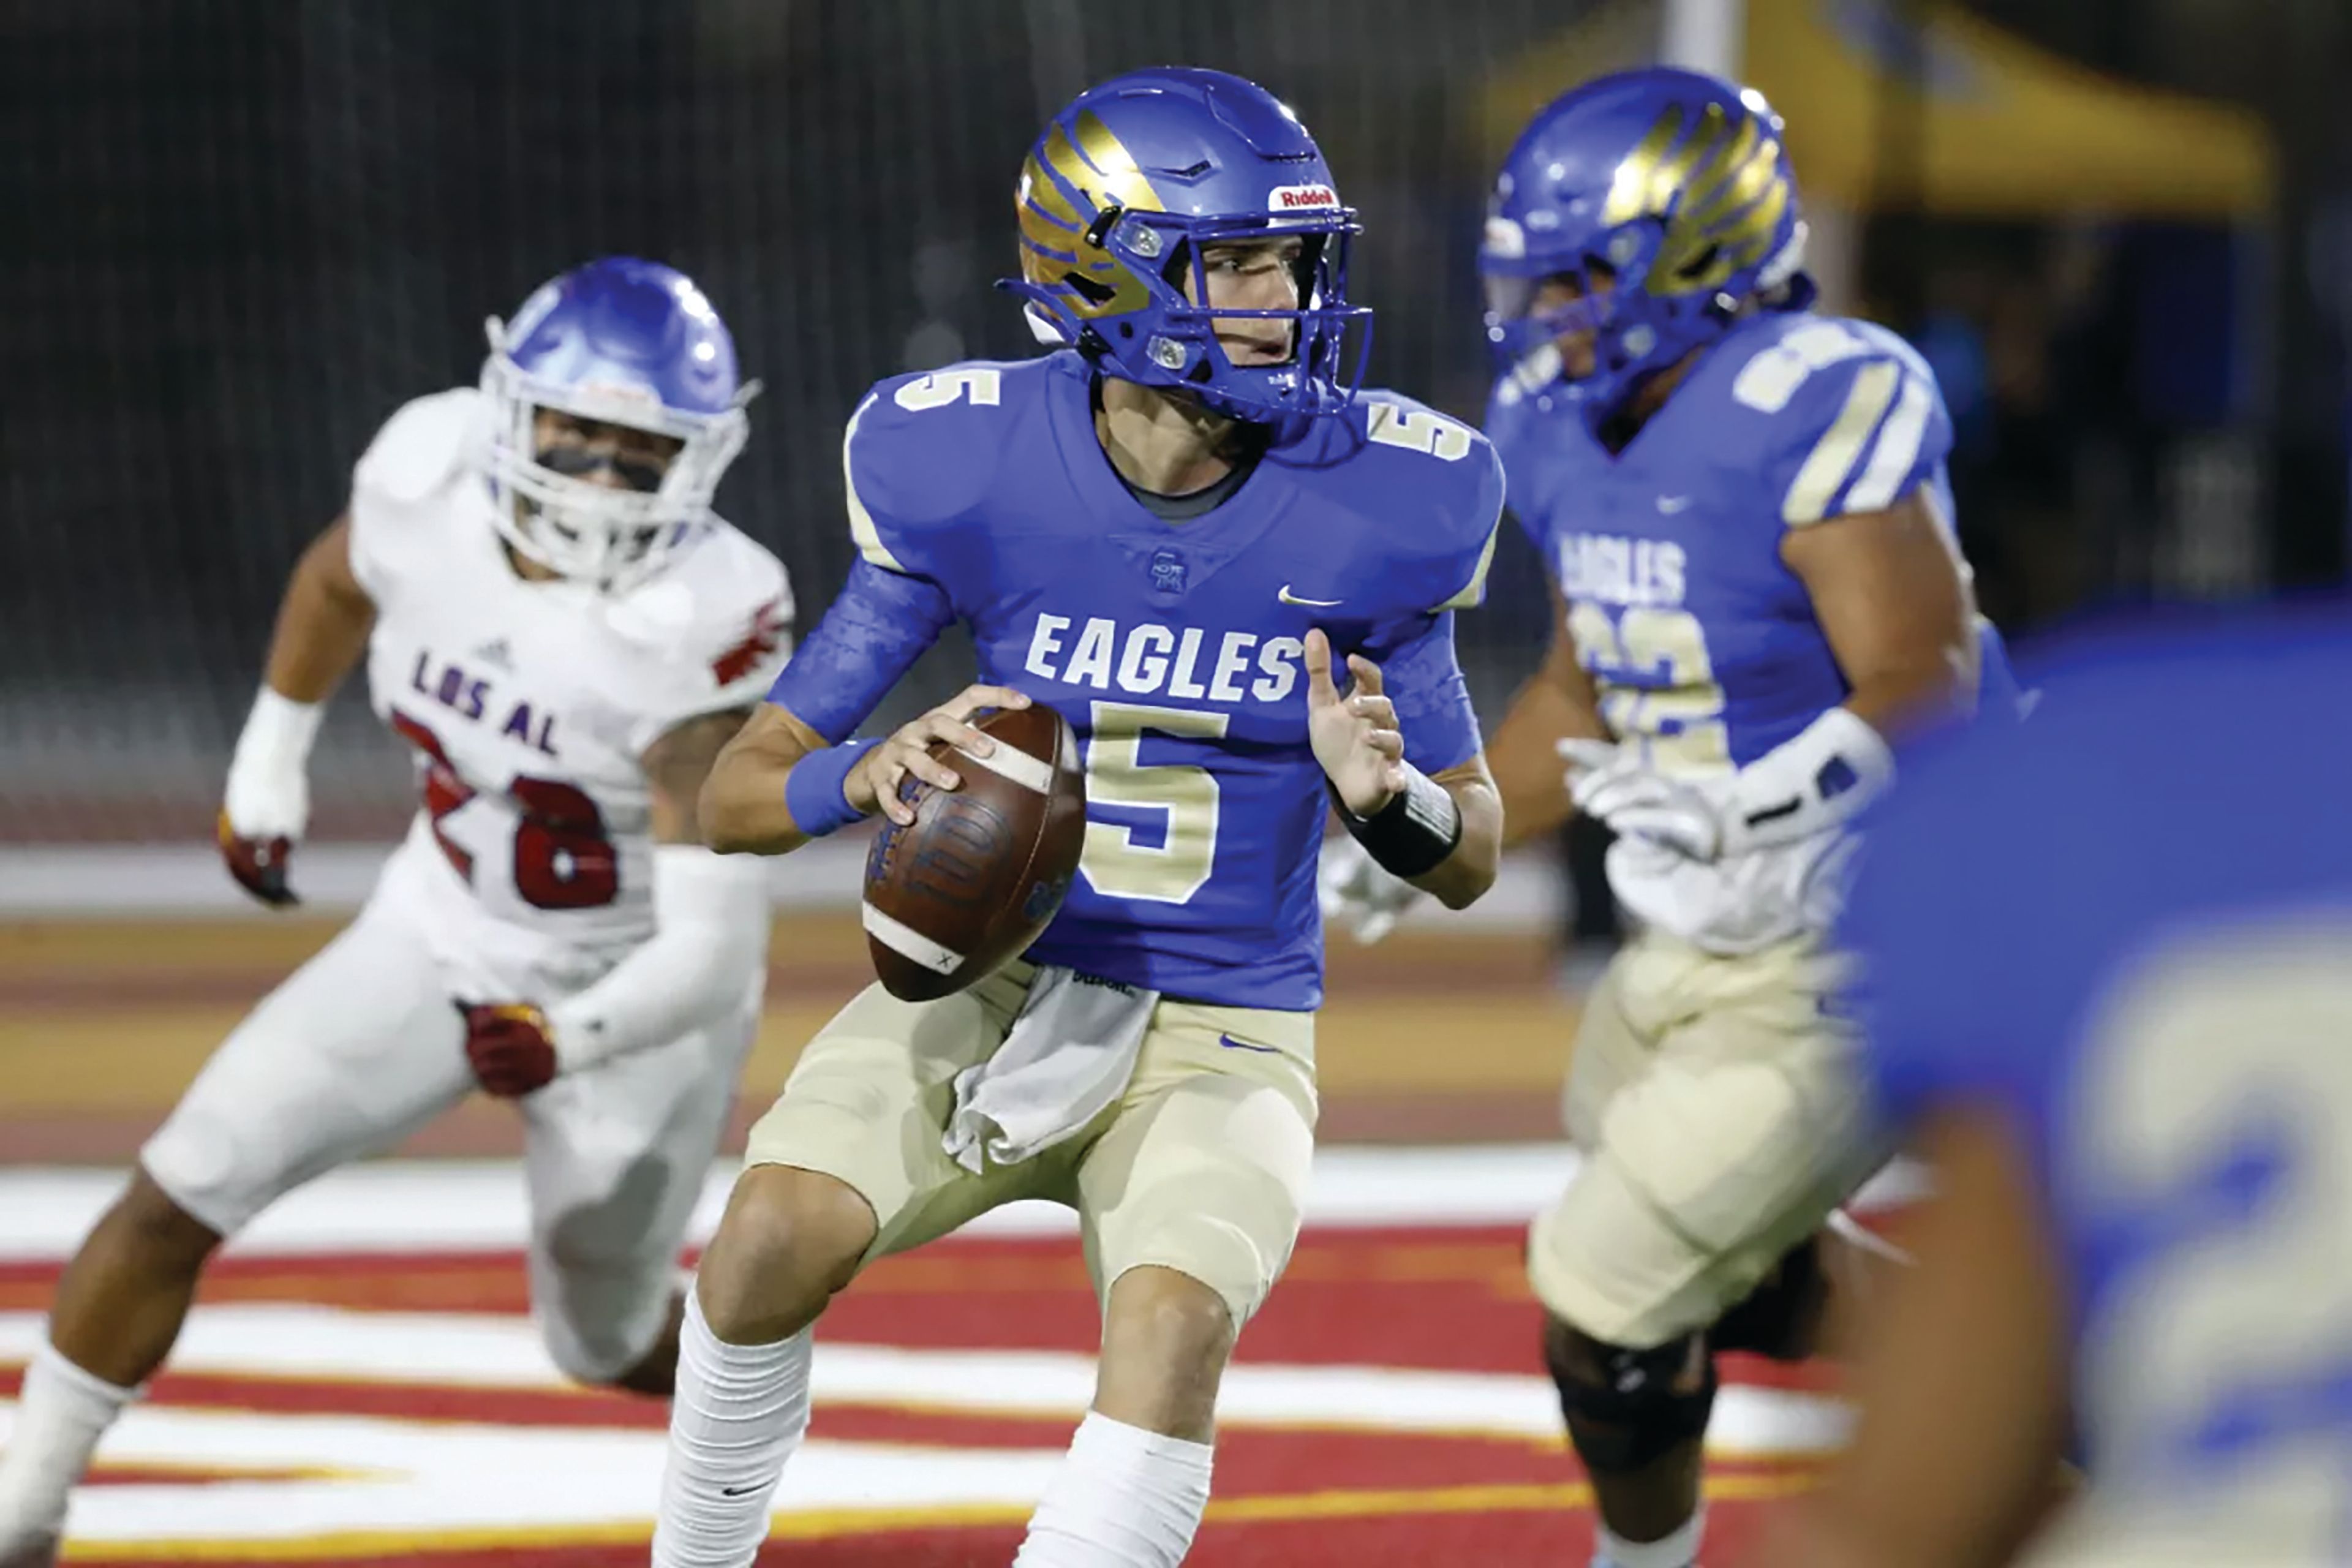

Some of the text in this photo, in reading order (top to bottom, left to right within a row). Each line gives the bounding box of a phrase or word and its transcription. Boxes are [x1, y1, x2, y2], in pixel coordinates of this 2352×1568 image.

[1281, 189, 1333, 206] Riddell
[894, 368, 1001, 413] 5
[1367, 400, 1471, 462] 5
[1024, 612, 1305, 703] EAGLES
[412, 650, 559, 756] LOS AL
[1078, 699, 1230, 905] 5
